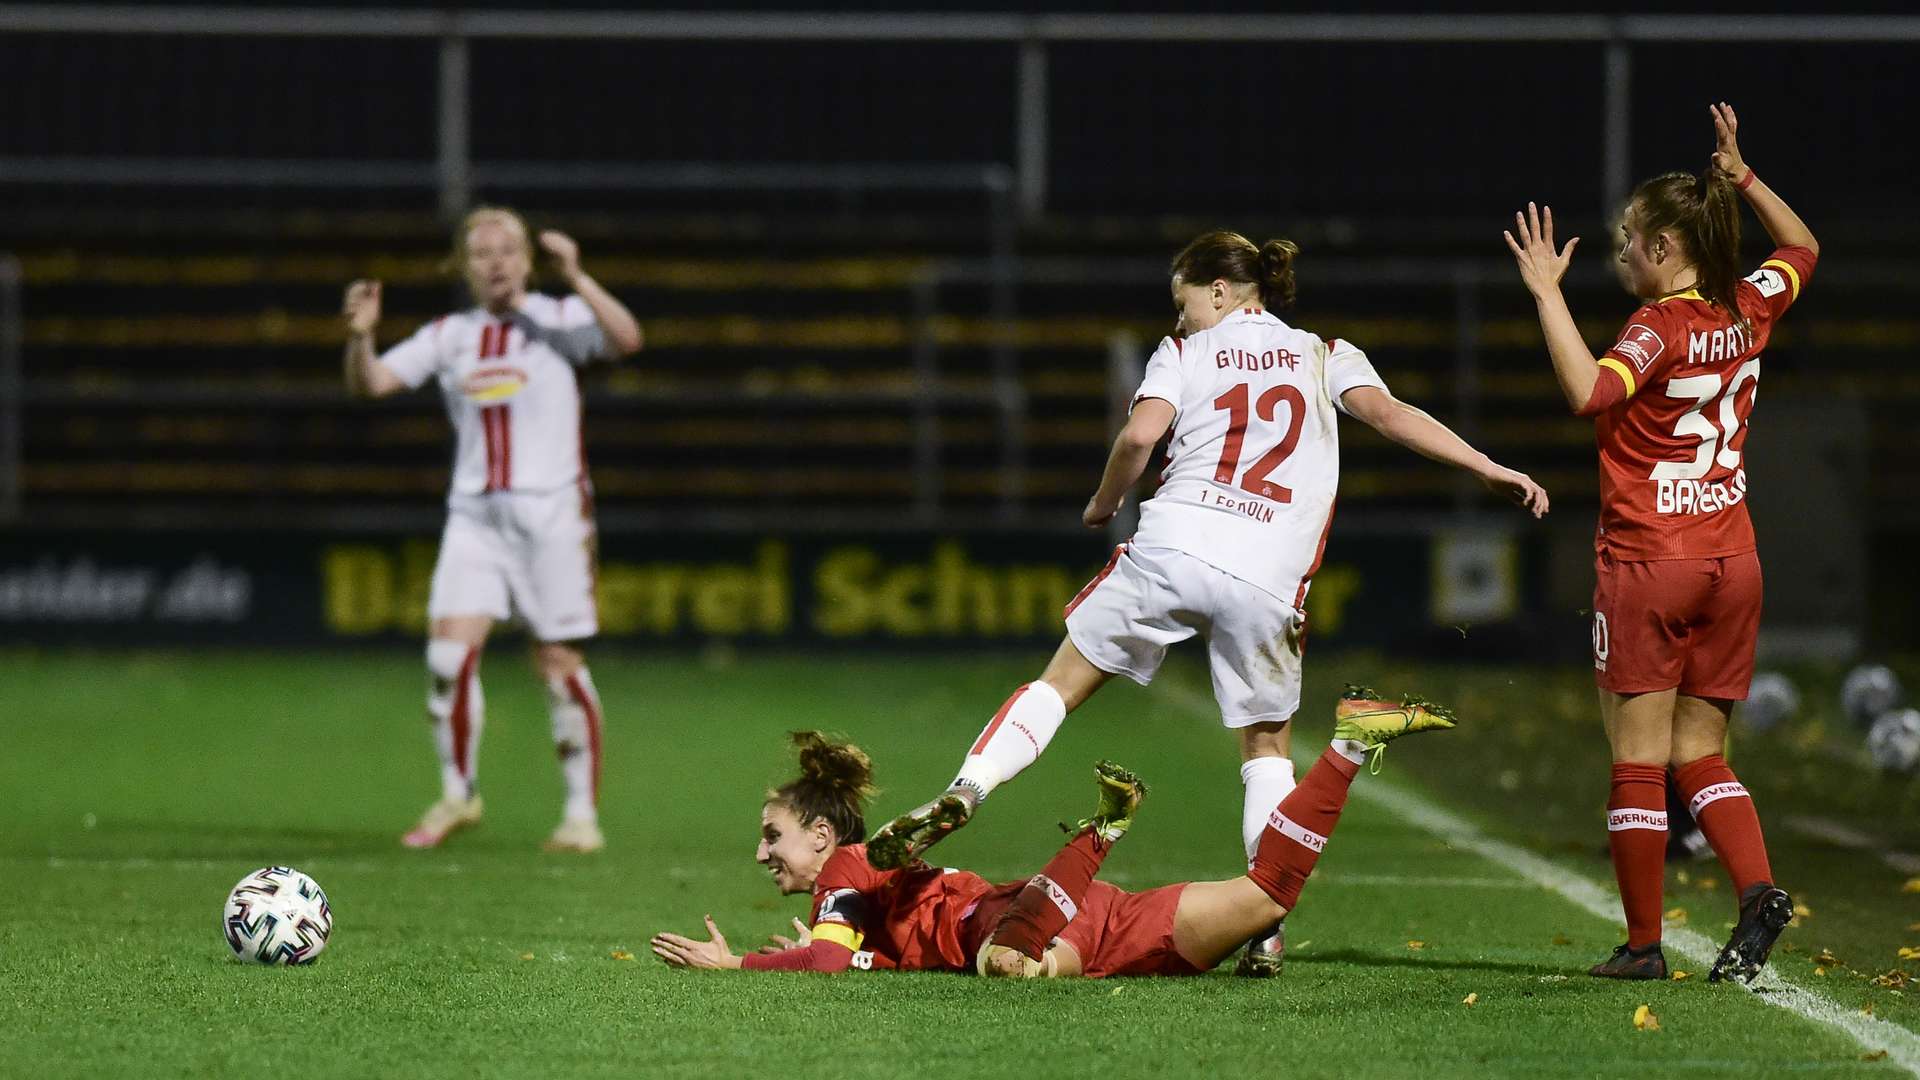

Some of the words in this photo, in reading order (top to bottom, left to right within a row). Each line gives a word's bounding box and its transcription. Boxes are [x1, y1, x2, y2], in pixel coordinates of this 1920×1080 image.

[1216, 348, 1302, 372] GUDORF
[1213, 382, 1306, 504] 12
[1609, 813, 1667, 826] LEVERKUSE
